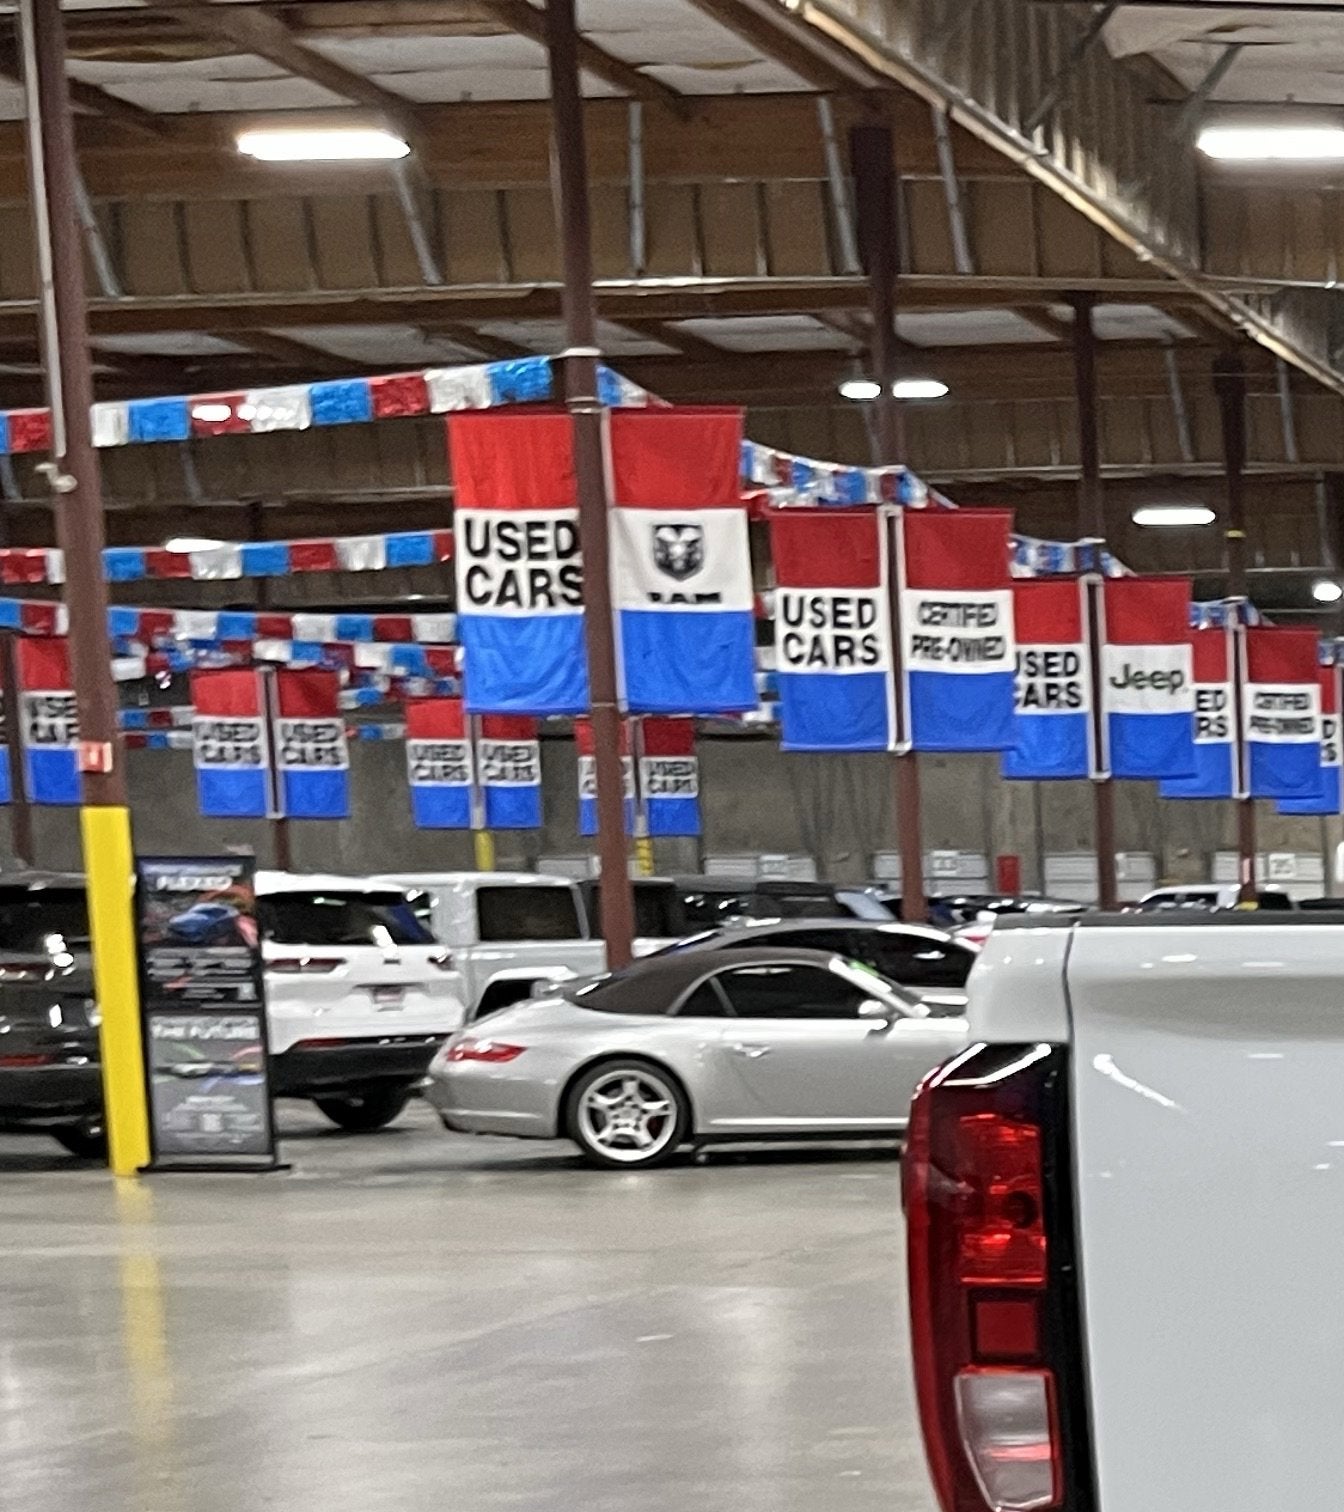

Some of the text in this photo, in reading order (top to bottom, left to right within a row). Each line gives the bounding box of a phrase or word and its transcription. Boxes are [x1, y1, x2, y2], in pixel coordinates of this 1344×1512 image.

[464, 518, 578, 562] USED
[466, 564, 583, 608] CARS
[783, 595, 876, 629] USED
[783, 632, 880, 667] CARS
[1016, 651, 1080, 678] SED
[1016, 681, 1082, 708] ARS
[1108, 663, 1185, 695] Jeep
[1196, 690, 1227, 712] ED
